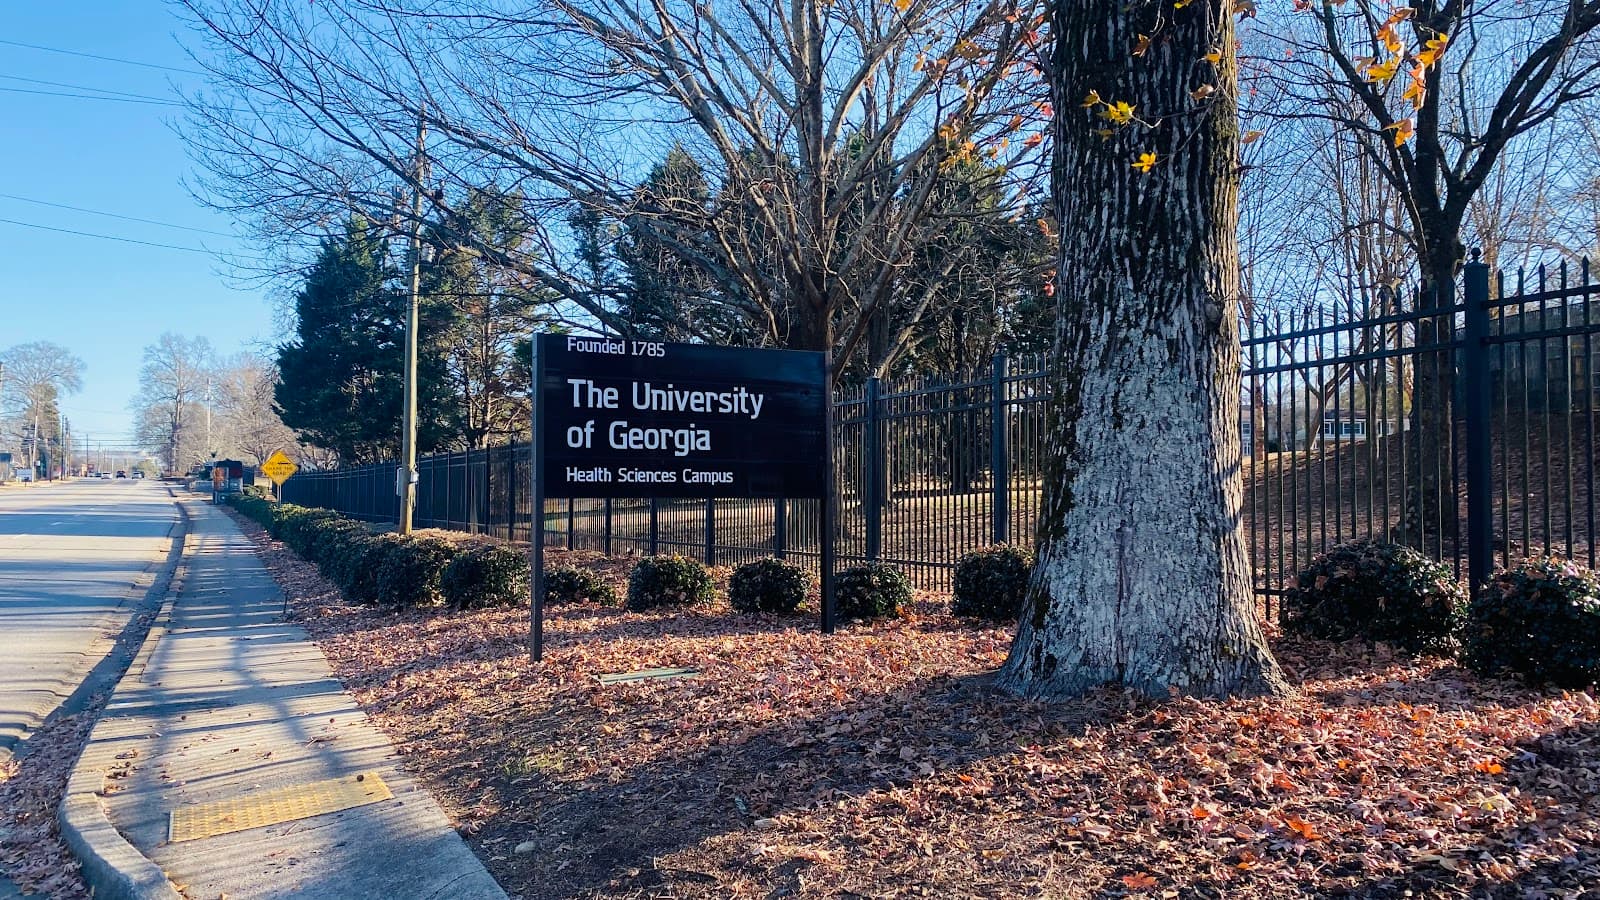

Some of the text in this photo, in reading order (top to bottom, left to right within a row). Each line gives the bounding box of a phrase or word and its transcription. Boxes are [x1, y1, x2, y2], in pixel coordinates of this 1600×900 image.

[567, 337, 666, 357] Founded 1785
[567, 378, 764, 419] The University
[567, 420, 711, 456] of Georgia
[566, 467, 734, 485] Health Sciences Campus
